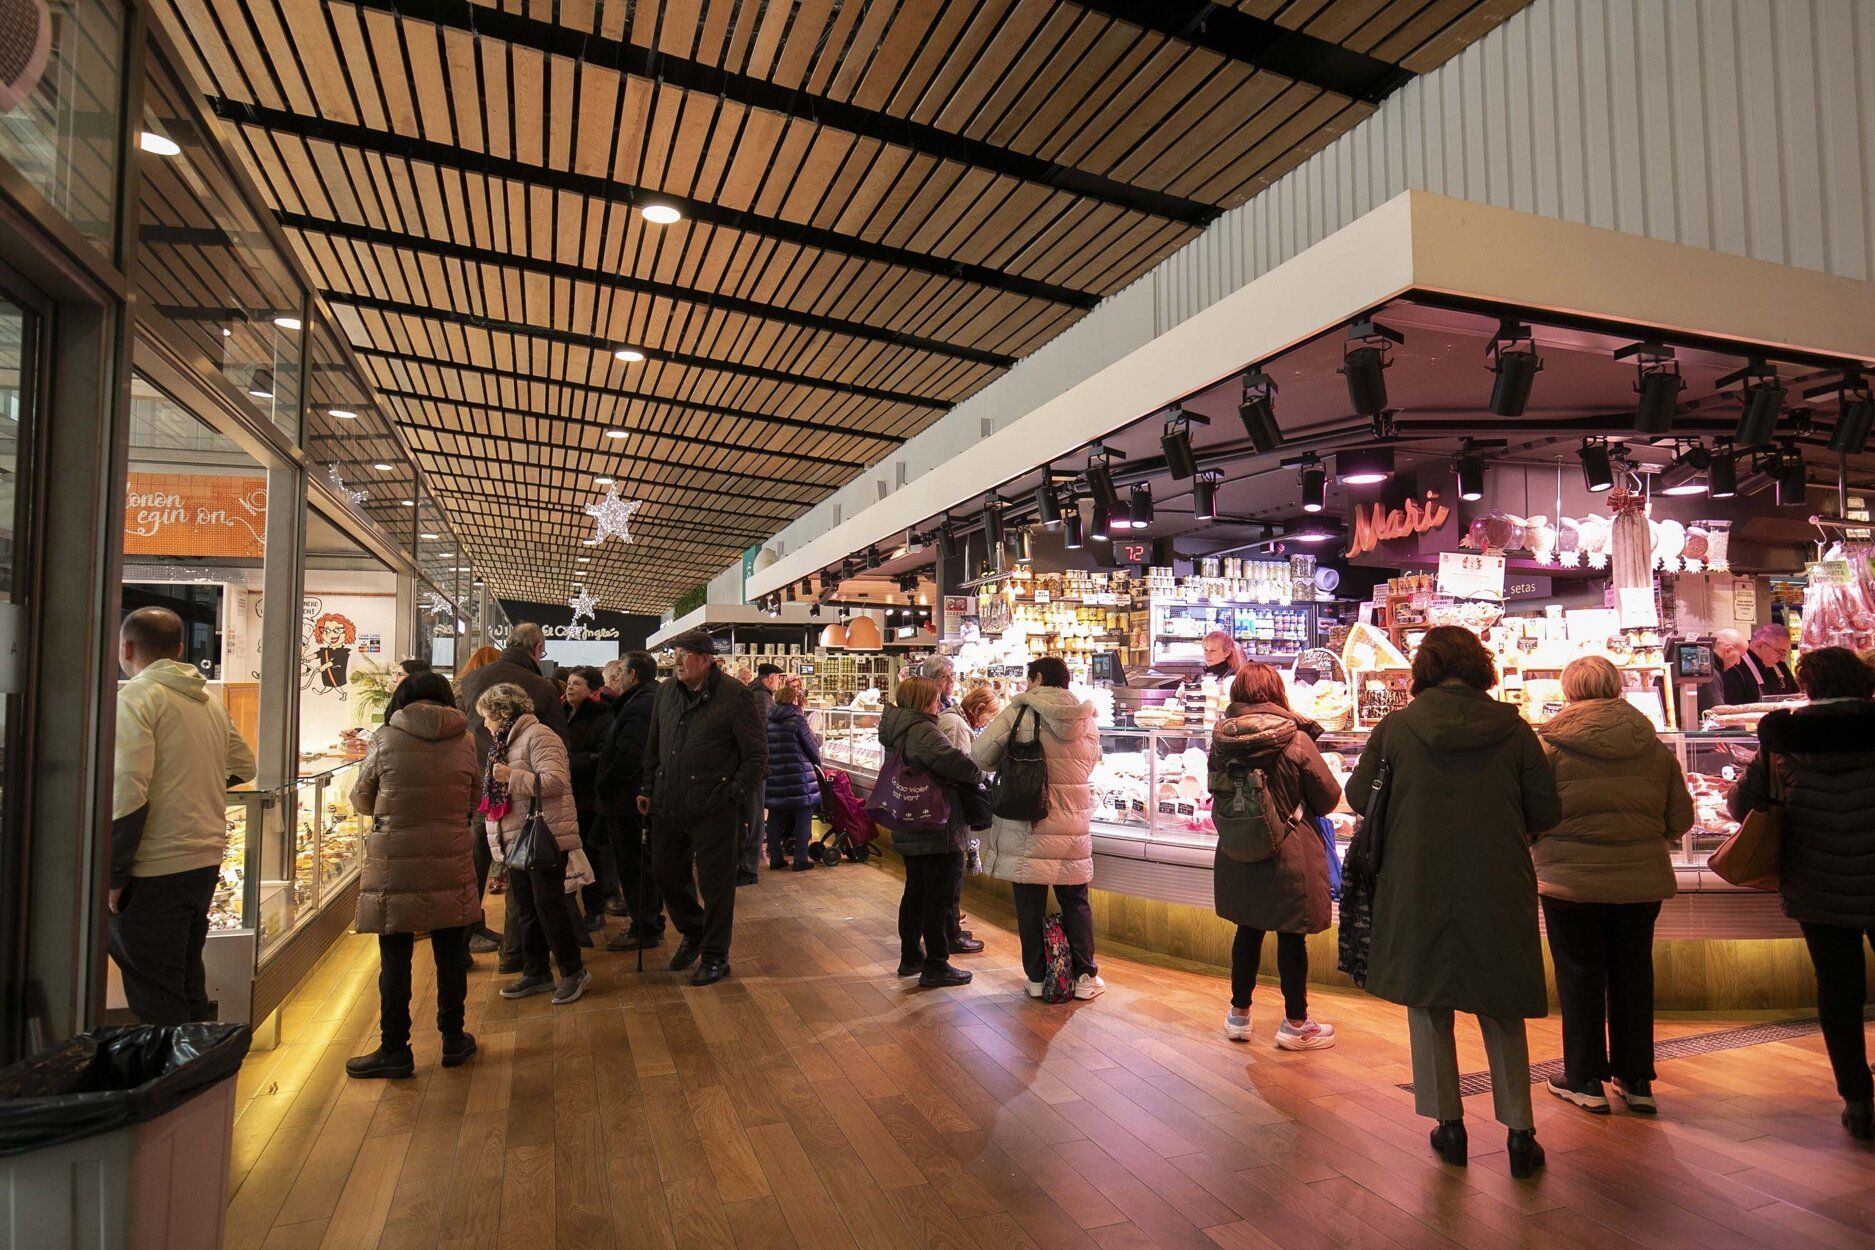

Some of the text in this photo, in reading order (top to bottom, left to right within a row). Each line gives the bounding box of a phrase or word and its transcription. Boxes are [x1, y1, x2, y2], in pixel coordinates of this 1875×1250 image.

[137, 508, 189, 536] egin
[1125, 546, 1144, 561] 72
[1510, 582, 1536, 594] setas
[541, 625, 554, 637] El
